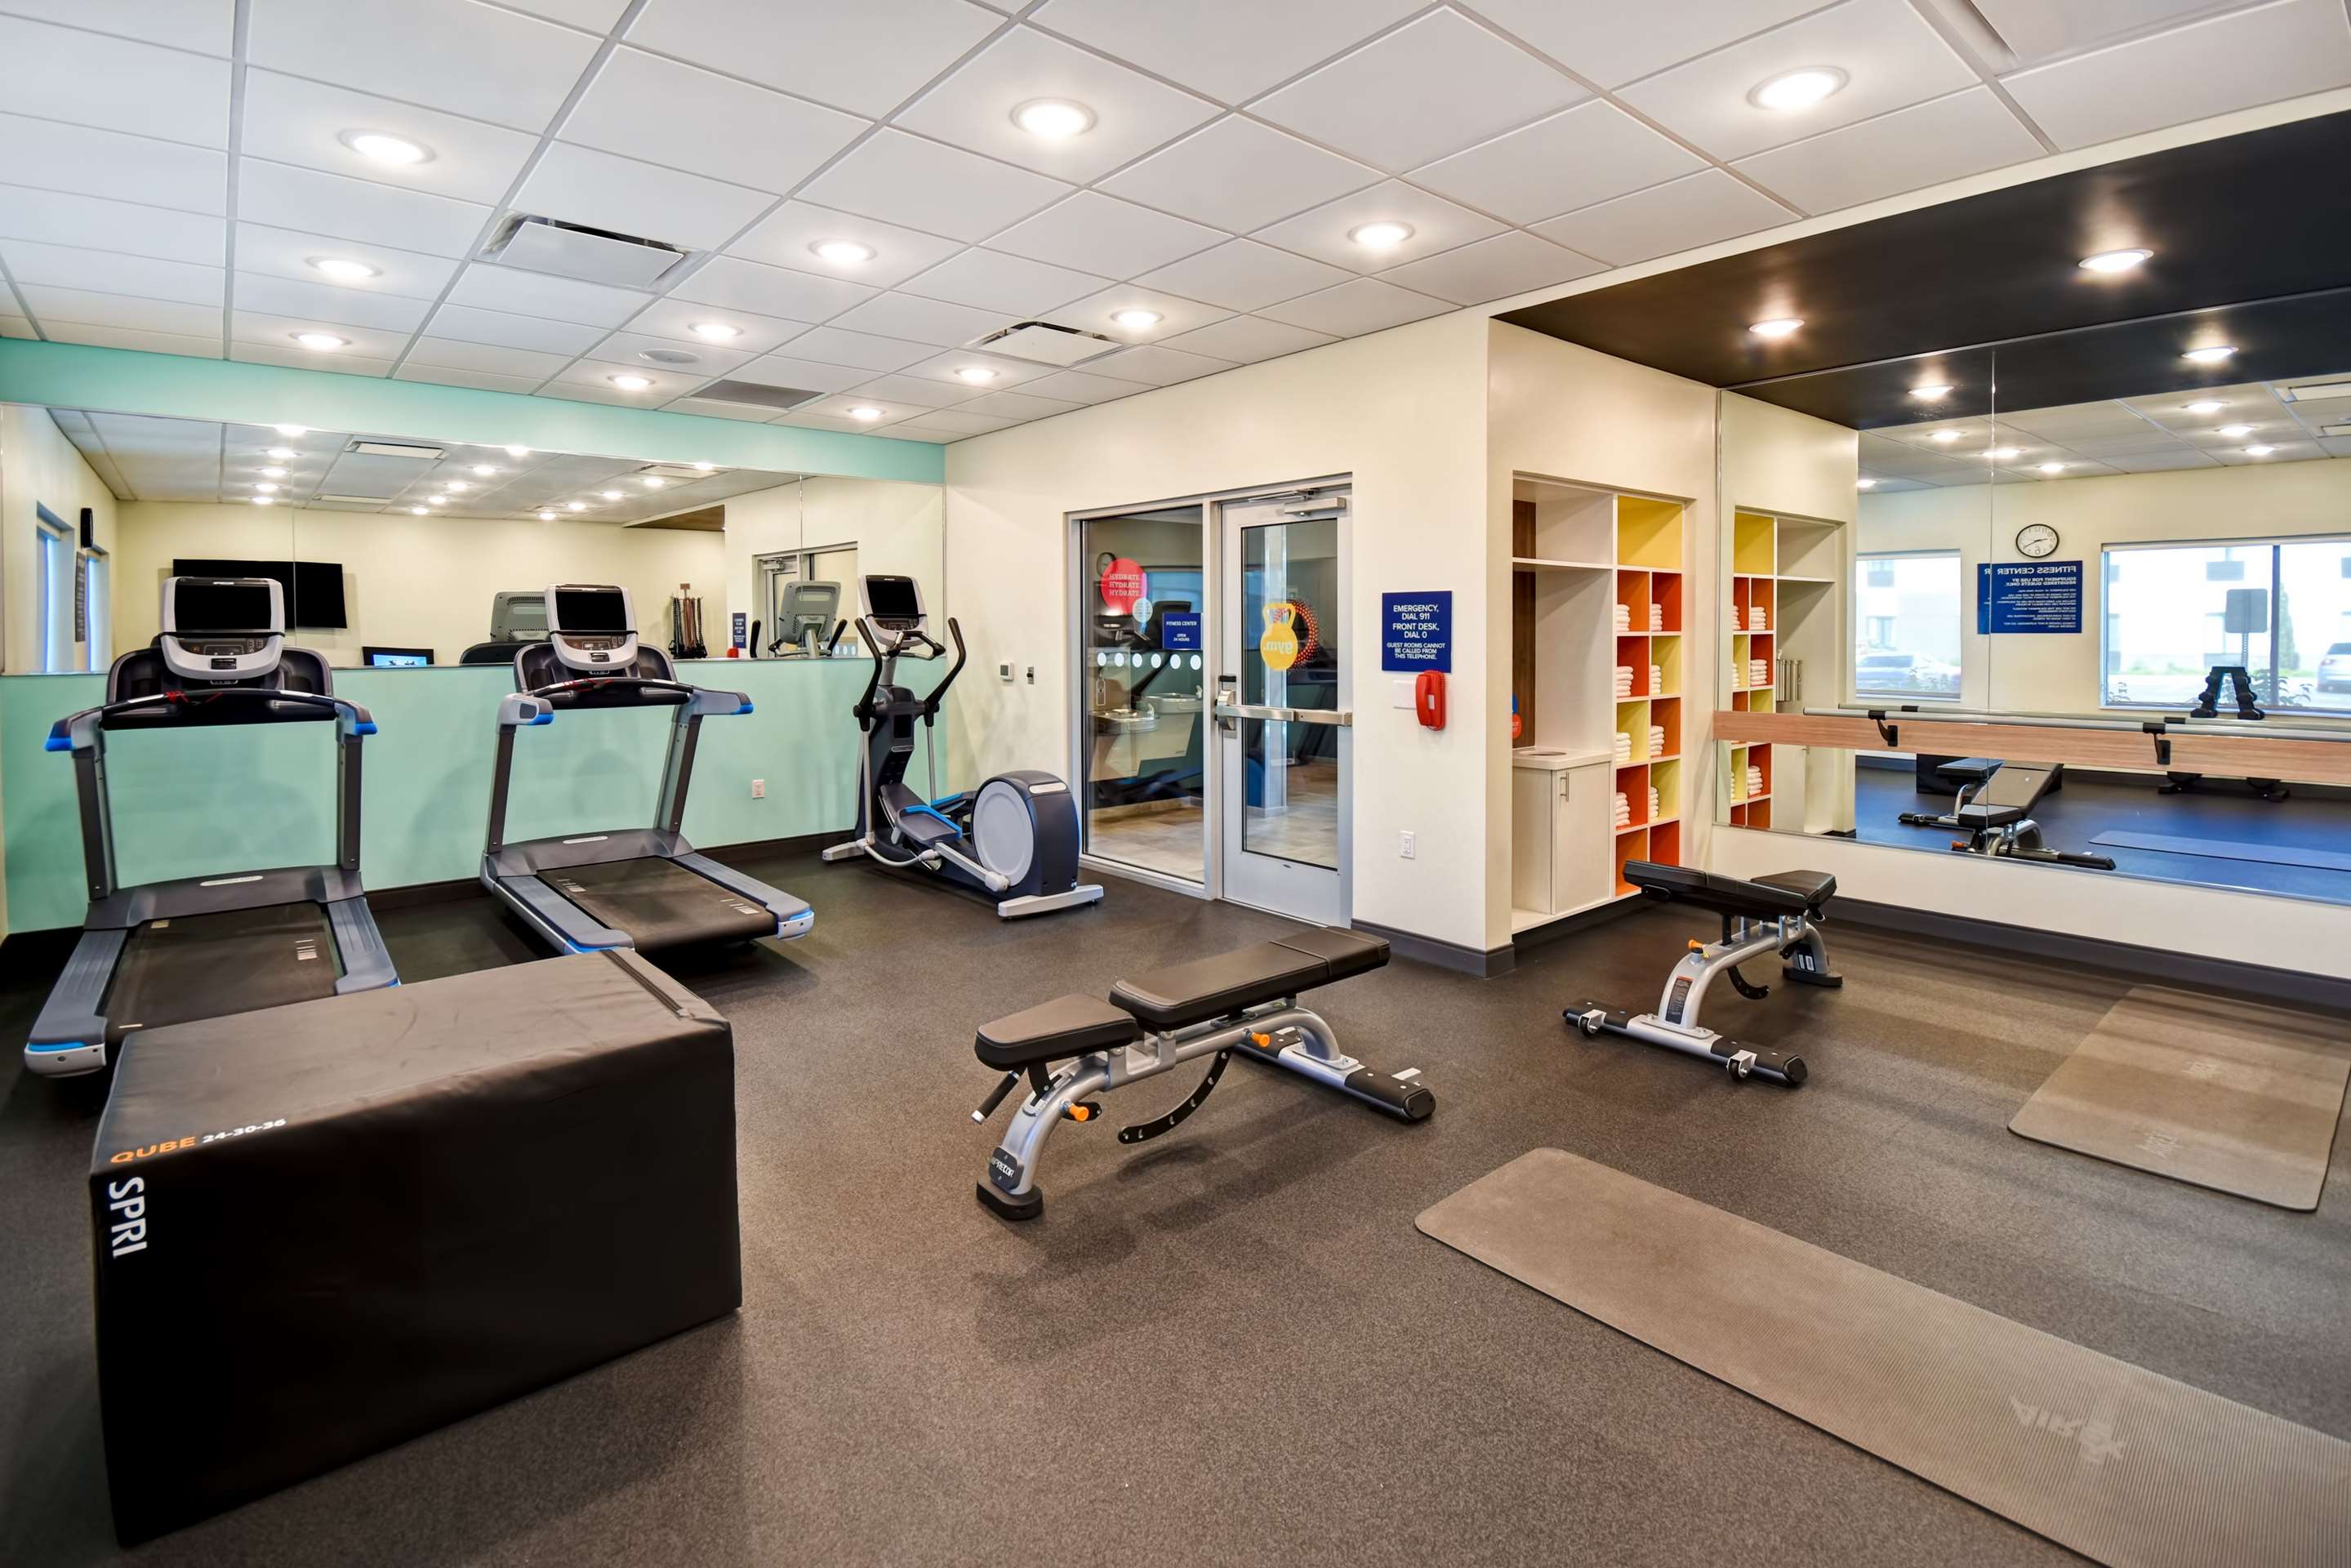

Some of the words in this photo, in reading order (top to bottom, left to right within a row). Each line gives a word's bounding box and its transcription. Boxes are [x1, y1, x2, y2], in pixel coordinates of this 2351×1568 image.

[1393, 604, 1439, 612] EMERGENCY,
[110, 1136, 197, 1164] QUBE
[202, 1118, 287, 1144] 24-30-36
[109, 1176, 148, 1259] SPRI
